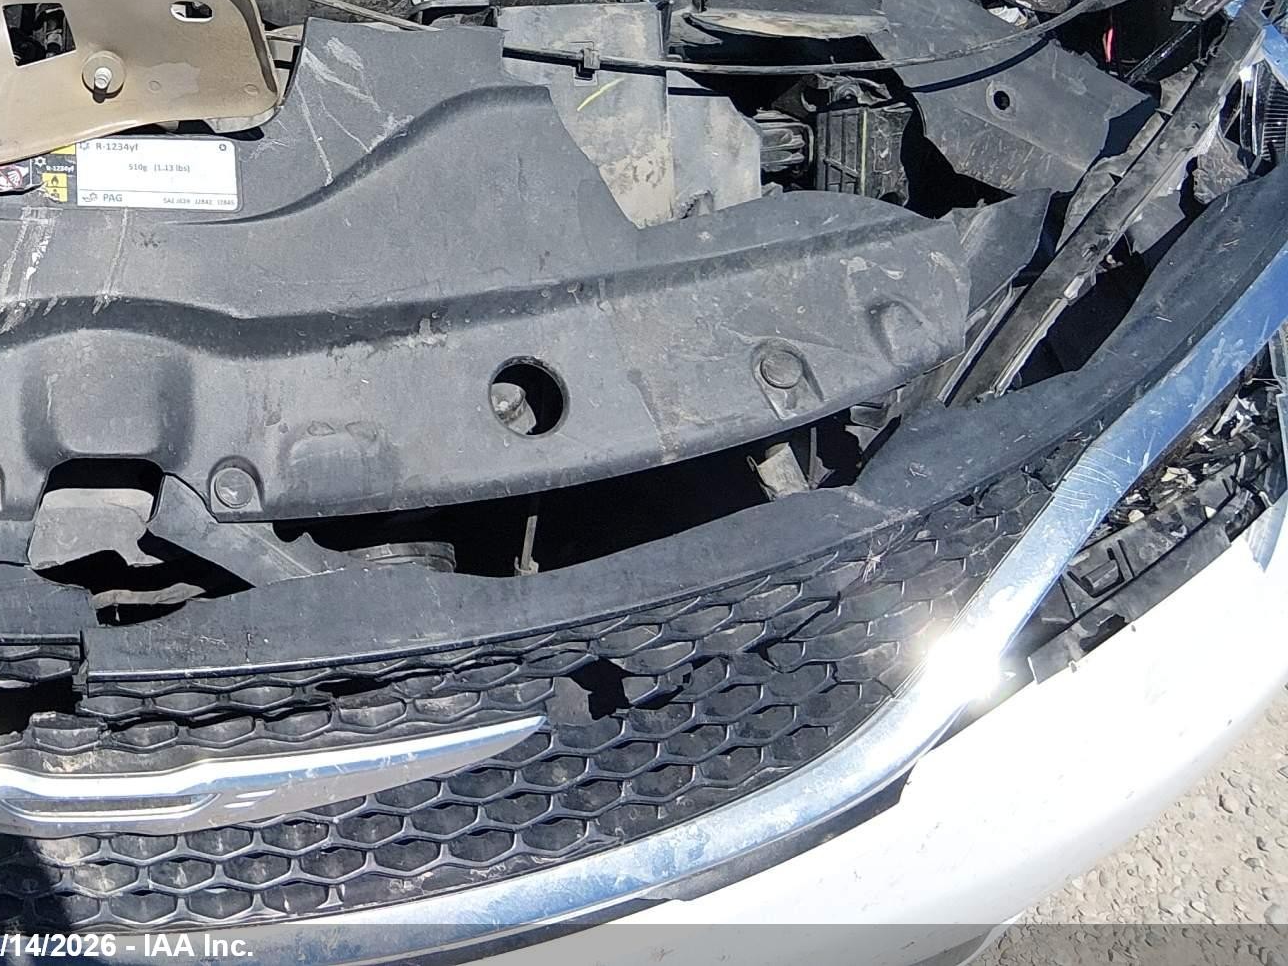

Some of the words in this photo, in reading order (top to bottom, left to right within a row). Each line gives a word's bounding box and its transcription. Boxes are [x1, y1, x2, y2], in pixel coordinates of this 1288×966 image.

[95, 142, 139, 153] R-1234yf
[128, 163, 148, 173] 510g
[102, 193, 123, 203] PAG
